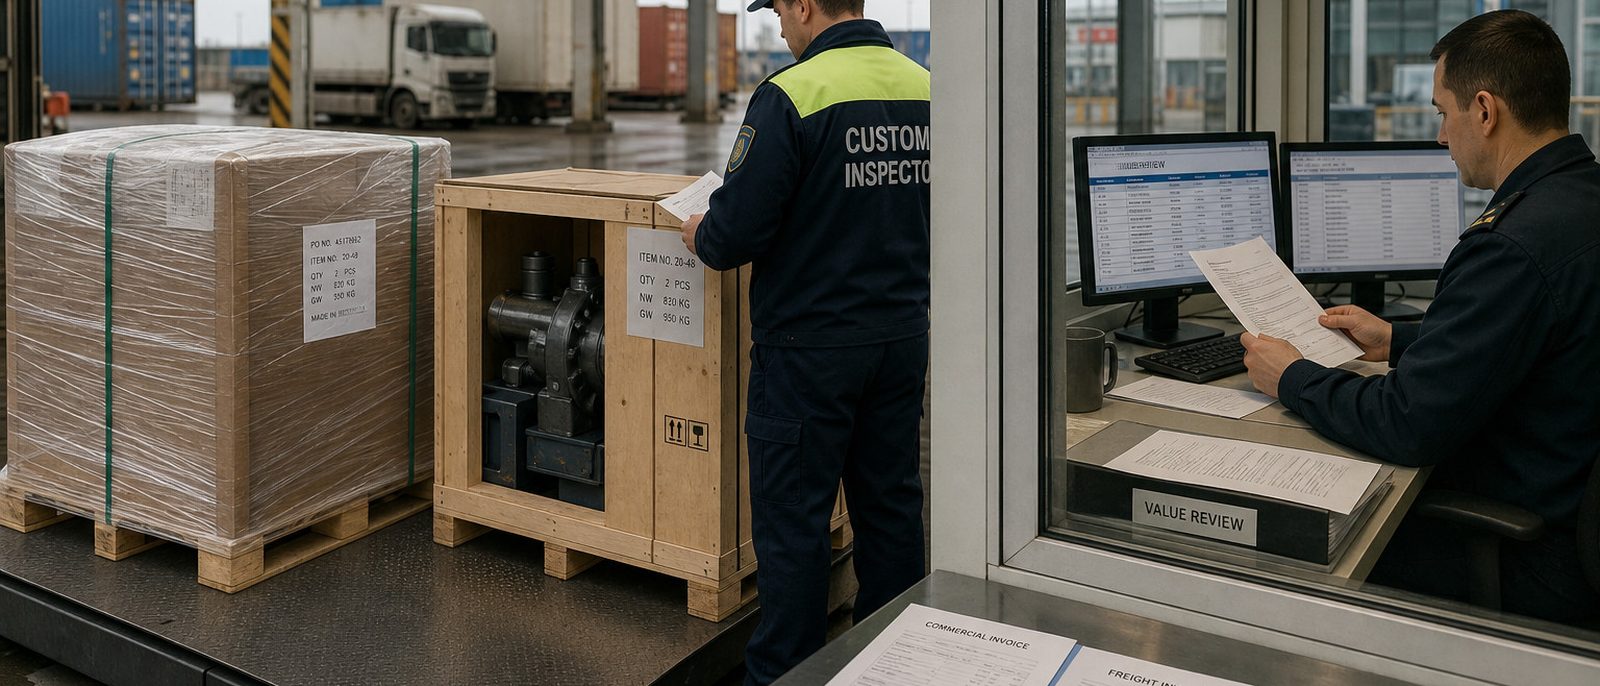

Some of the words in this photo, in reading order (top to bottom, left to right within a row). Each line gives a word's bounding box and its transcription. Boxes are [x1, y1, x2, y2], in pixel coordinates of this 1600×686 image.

[845, 125, 930, 154] CUSTOM
[845, 160, 931, 188] INSPECTO
[310, 240, 320, 248] PO
[310, 256, 326, 265] ITEM
[640, 252, 658, 263] ITEM
[659, 255, 673, 266] NO.
[674, 257, 696, 268] 20-48
[344, 268, 356, 276] PCS
[310, 284, 322, 292] NW
[640, 275, 655, 285] QTY
[665, 278, 669, 288] 2
[674, 280, 690, 290] PCS
[310, 295, 323, 304] GW
[346, 290, 356, 298] KG
[640, 292, 653, 303] NW
[663, 297, 677, 306] 820
[679, 299, 690, 309] KG
[311, 313, 328, 321] MADE
[329, 310, 337, 318] IN
[640, 309, 653, 319] GW
[663, 313, 677, 322] 950
[679, 315, 690, 325] KG
[1144, 501, 1187, 521] VALUE
[1191, 510, 1245, 532] REVIEW
[925, 621, 988, 641] COMMERCIAL
[989, 635, 1031, 650] INVOICE
[1107, 668, 1159, 686] FREIGHT
